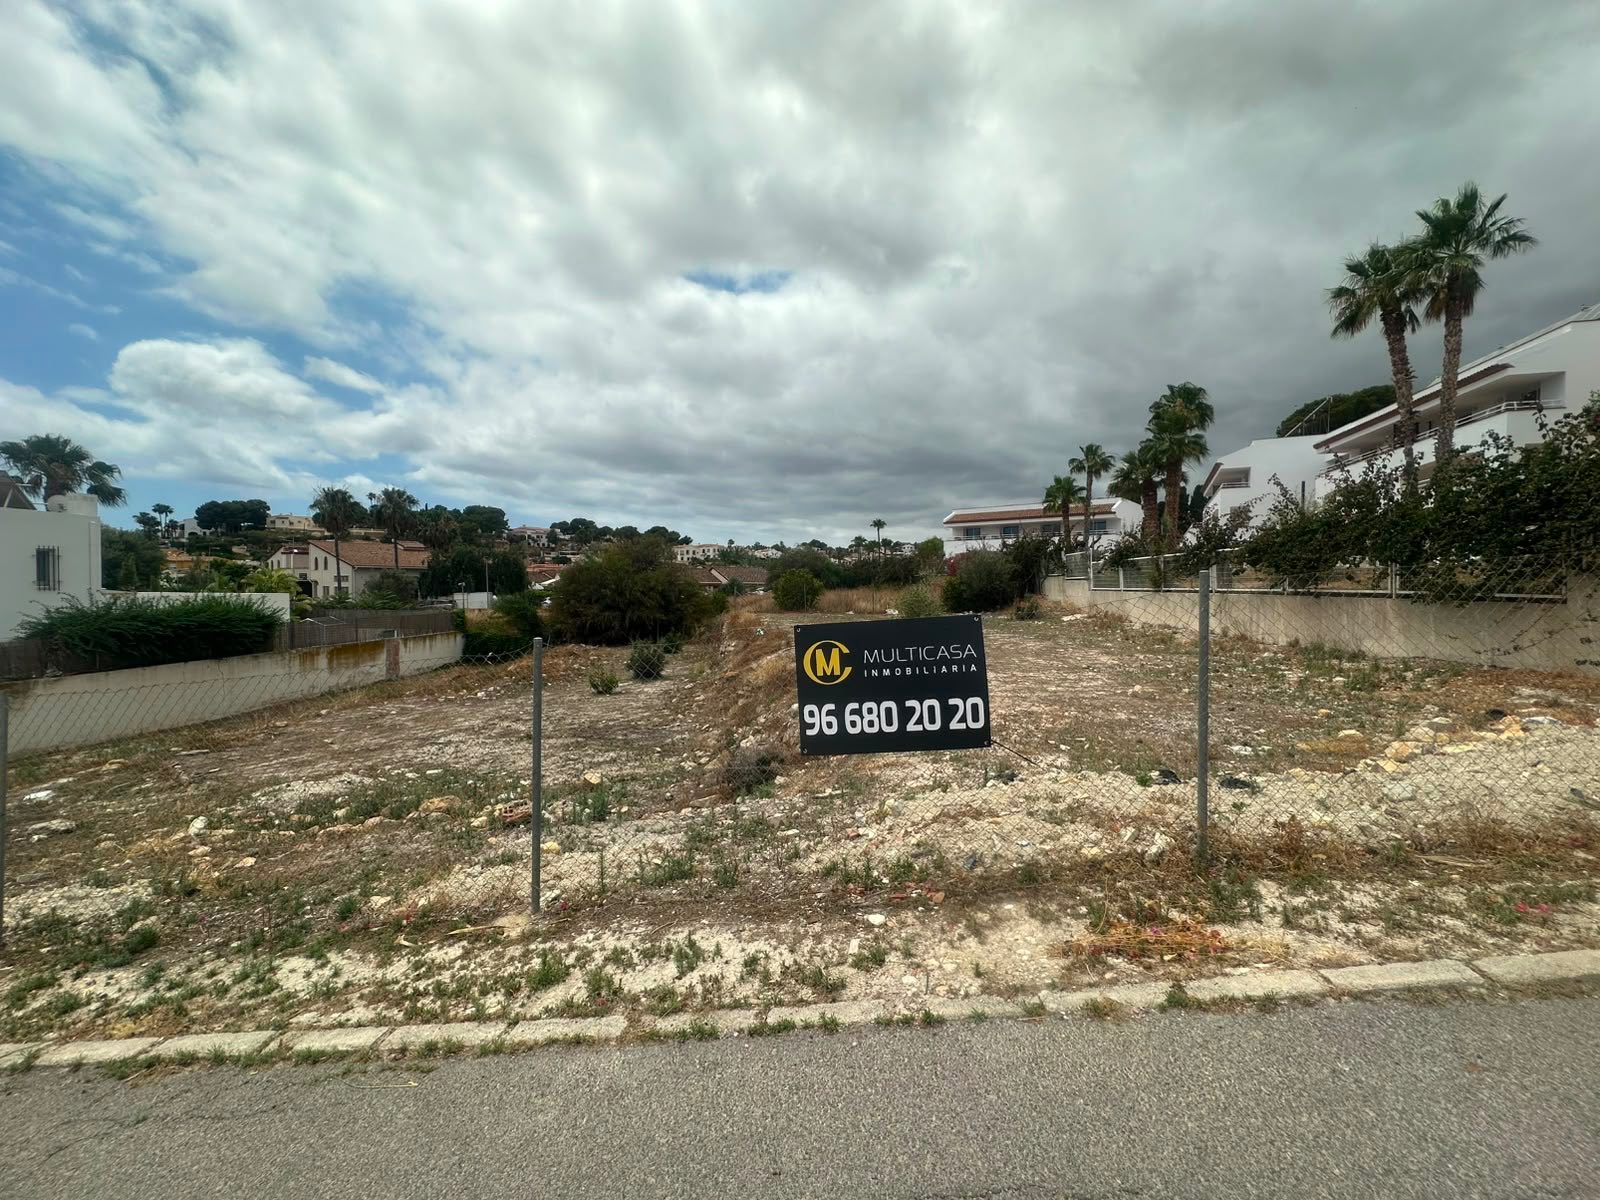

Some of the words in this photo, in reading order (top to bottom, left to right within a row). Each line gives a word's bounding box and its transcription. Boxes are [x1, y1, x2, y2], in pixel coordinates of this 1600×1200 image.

[864, 644, 977, 663] MULTICASA
[864, 664, 978, 677] INMOBILIARIA
[803, 703, 838, 736] 96
[844, 700, 899, 735] 680
[905, 698, 942, 732] 20
[948, 696, 985, 730] 20
